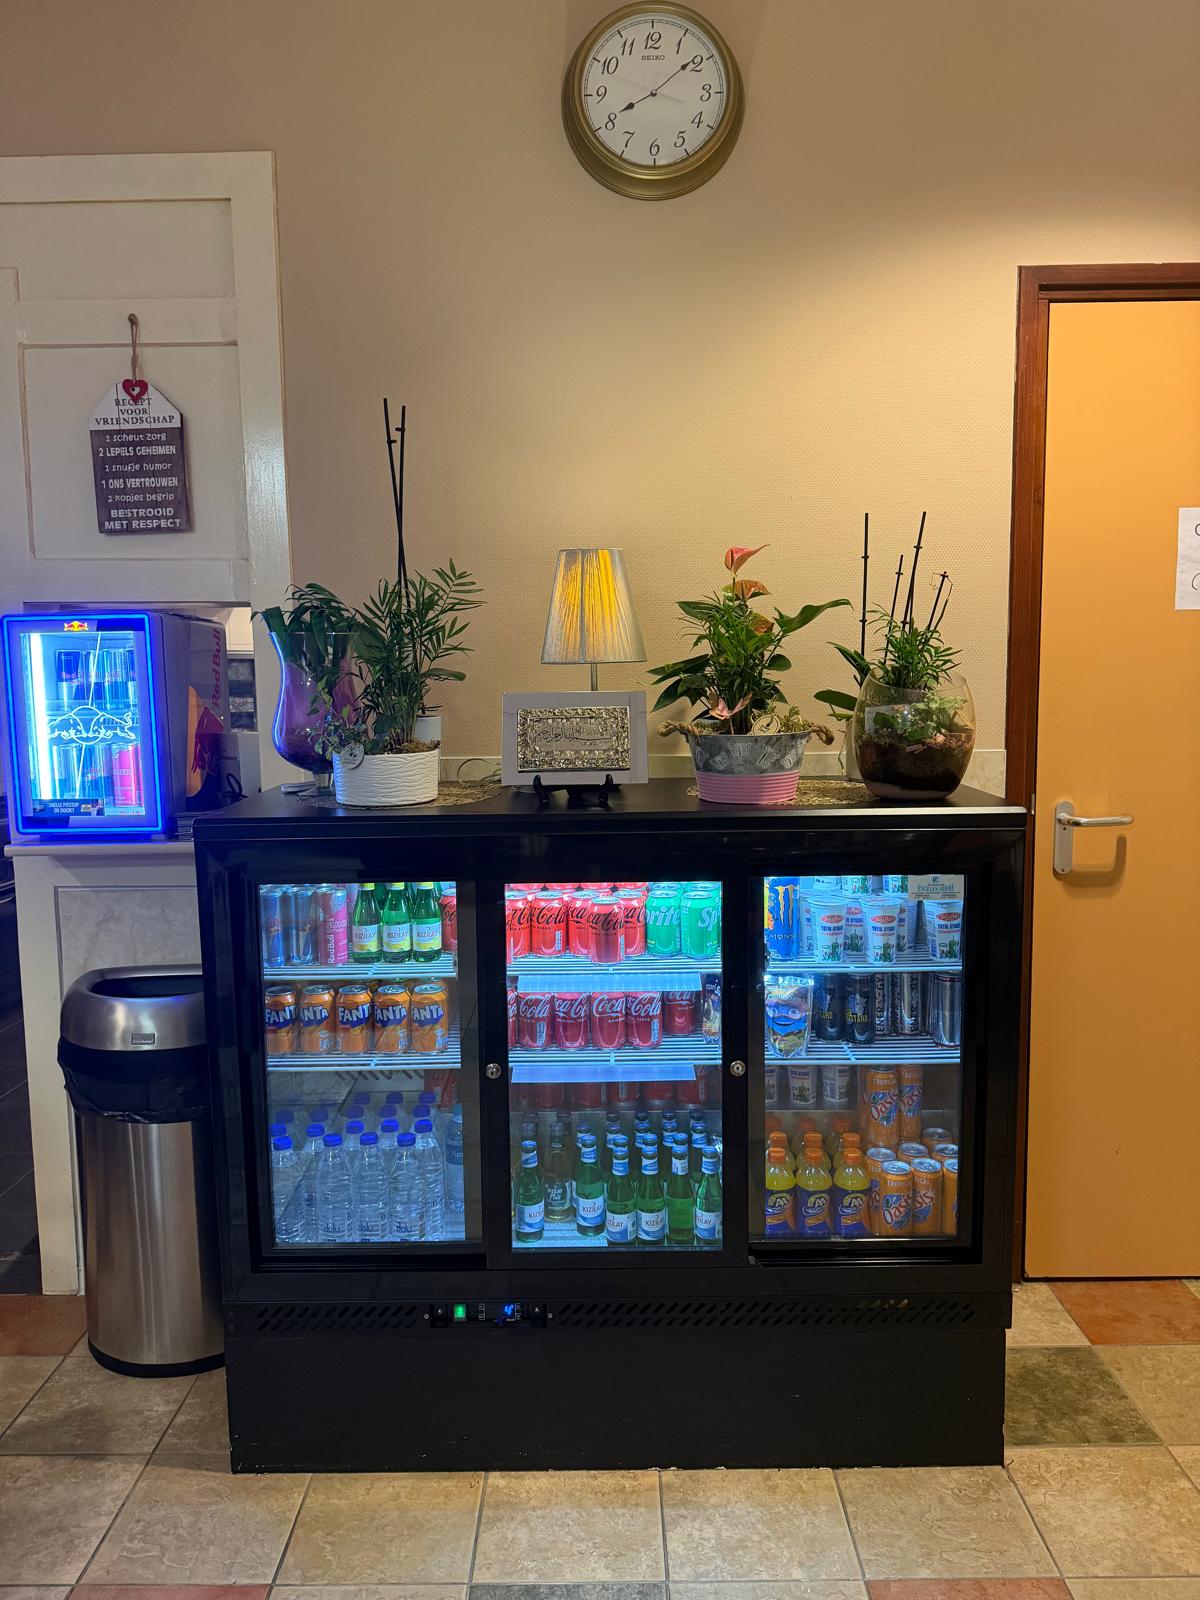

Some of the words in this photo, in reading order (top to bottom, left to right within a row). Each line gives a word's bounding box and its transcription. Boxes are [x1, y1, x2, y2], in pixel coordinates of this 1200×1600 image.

[621, 38, 636, 56] 11
[644, 31, 662, 50] 12
[675, 36, 683, 54] 1
[601, 56, 619, 75] 10
[690, 54, 704, 73] 2
[596, 85, 608, 104] 9
[699, 83, 712, 102] 3
[604, 112, 617, 131] 8
[691, 110, 704, 128] 4
[622, 131, 636, 148] 7
[650, 138, 660, 156] 6
[673, 130, 687, 148] 5
[95, 415, 175, 426] VRIENDSCHAP
[120, 407, 148, 416] VOOR
[146, 432, 167, 441] zorg
[99, 448, 104, 457] 2
[106, 447, 134, 457] LEPELS
[136, 445, 176, 456] GEHEIMEN
[105, 464, 110, 472] 1
[112, 462, 140, 472] snufje
[143, 462, 172, 471] humor
[101, 479, 106, 489] 1
[108, 478, 124, 489] ONS
[126, 476, 178, 488] VERTROUWEN
[107, 495, 113, 503] 2
[115, 493, 144, 503] kopjes
[146, 491, 175, 502] begrip
[110, 507, 174, 518] BESTROOID
[104, 520, 129, 530] MET
[132, 519, 181, 529] RESPECT
[212, 627, 221, 667] Bull
[212, 668, 221, 708] Red
[645, 905, 680, 926] rite
[265, 1004, 297, 1023] FANT
[300, 1005, 329, 1021] NTA
[338, 1003, 370, 1022] FANT
[375, 1004, 408, 1021] ANTA
[412, 1004, 444, 1020] ANTA
